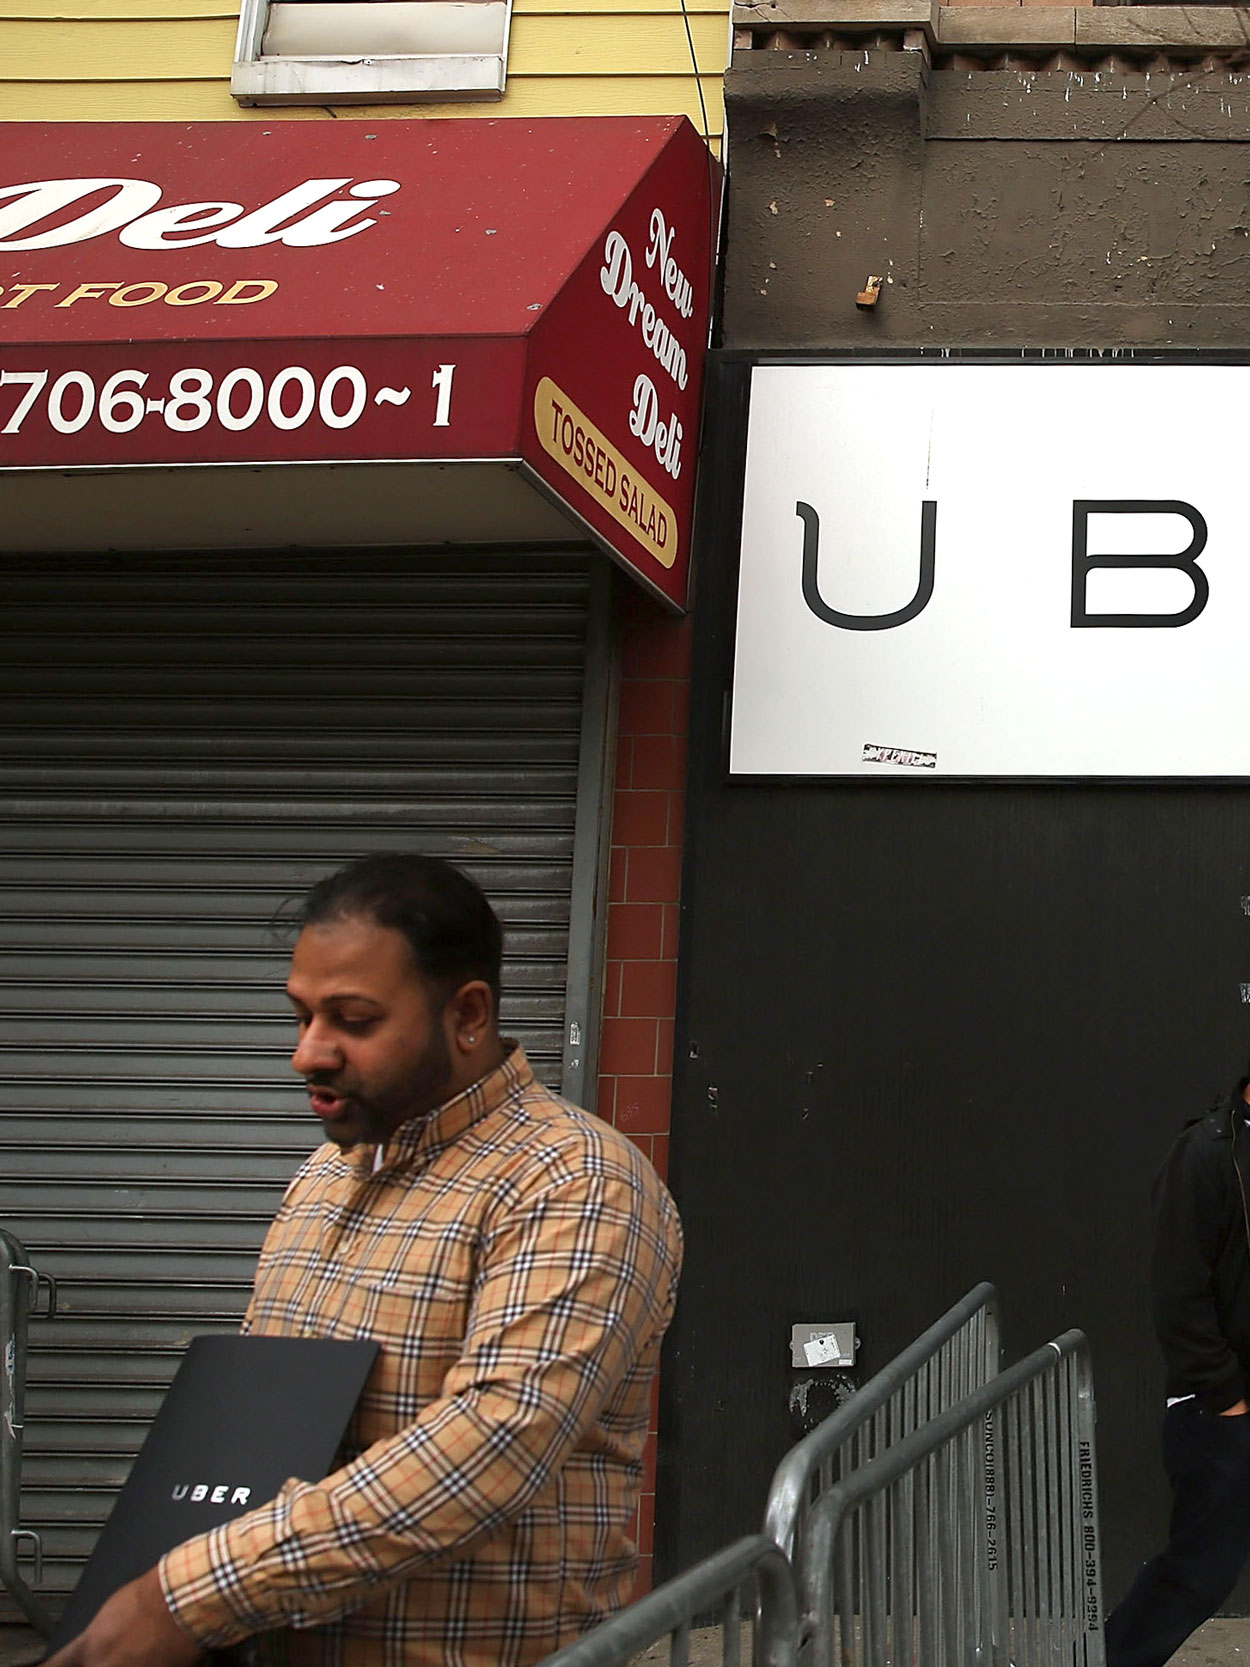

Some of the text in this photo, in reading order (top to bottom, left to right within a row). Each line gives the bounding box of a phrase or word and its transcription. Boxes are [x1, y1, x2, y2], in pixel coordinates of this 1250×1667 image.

[0, 280, 279, 309] T FOOD
[600, 230, 689, 390] Dream
[645, 208, 693, 318] New
[551, 399, 667, 549] TOSSED SALAD
[629, 373, 683, 480] Deli
[171, 1484, 251, 1505] UBER
[1079, 1441, 1094, 1519] FRIEDRICHS
